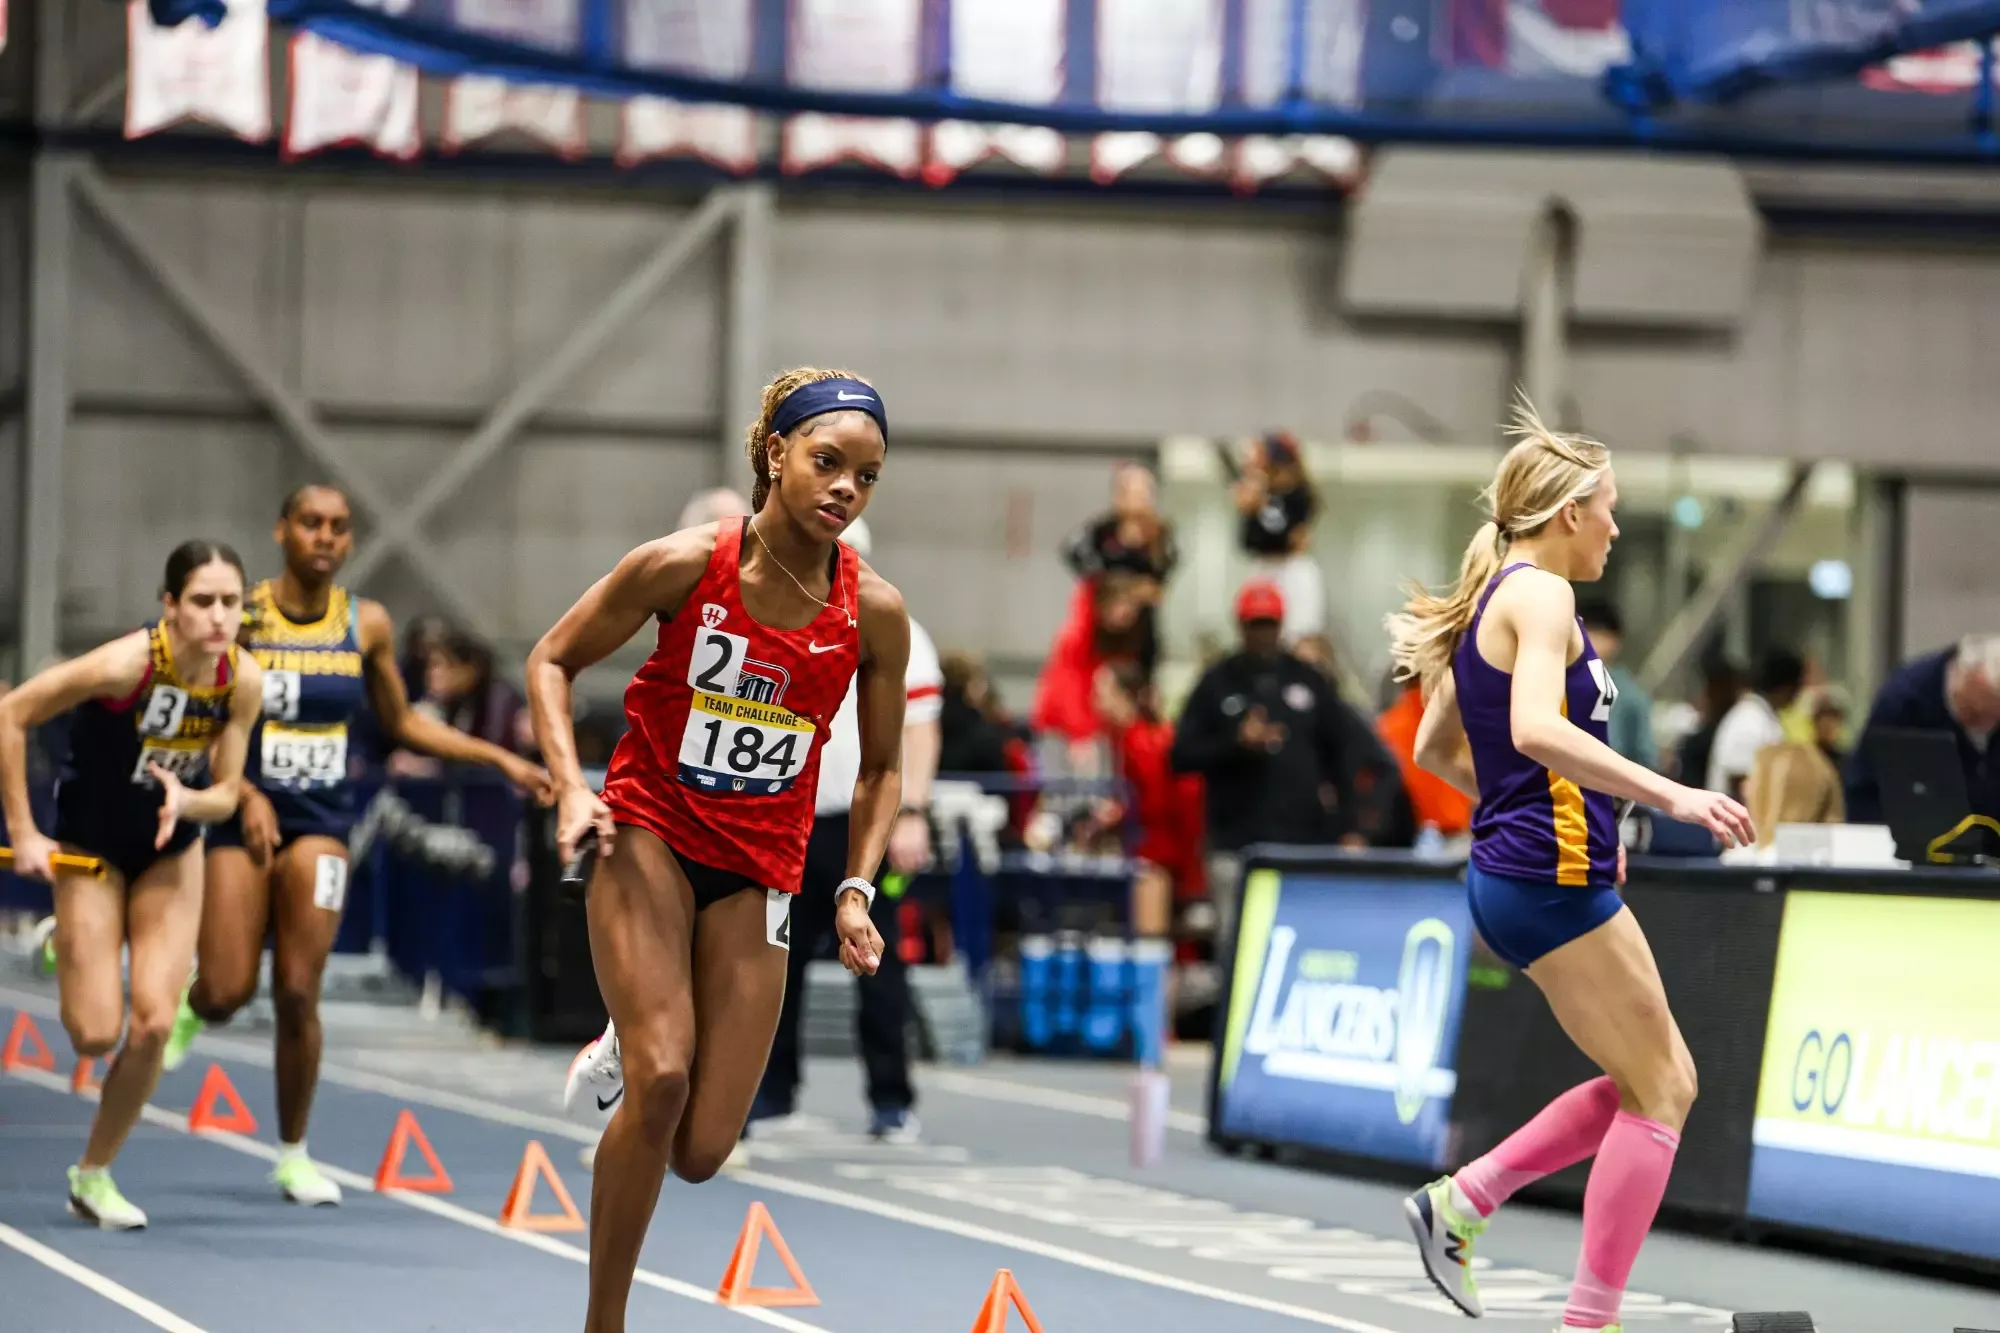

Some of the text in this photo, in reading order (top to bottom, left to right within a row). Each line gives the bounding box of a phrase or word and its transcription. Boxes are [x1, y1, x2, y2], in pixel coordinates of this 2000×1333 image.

[694, 634, 733, 694] 2
[149, 692, 178, 732] 3
[267, 672, 289, 718] 3
[704, 696, 733, 716] TEAM
[735, 705, 799, 728] CHALLENGE
[703, 719, 798, 777] 184
